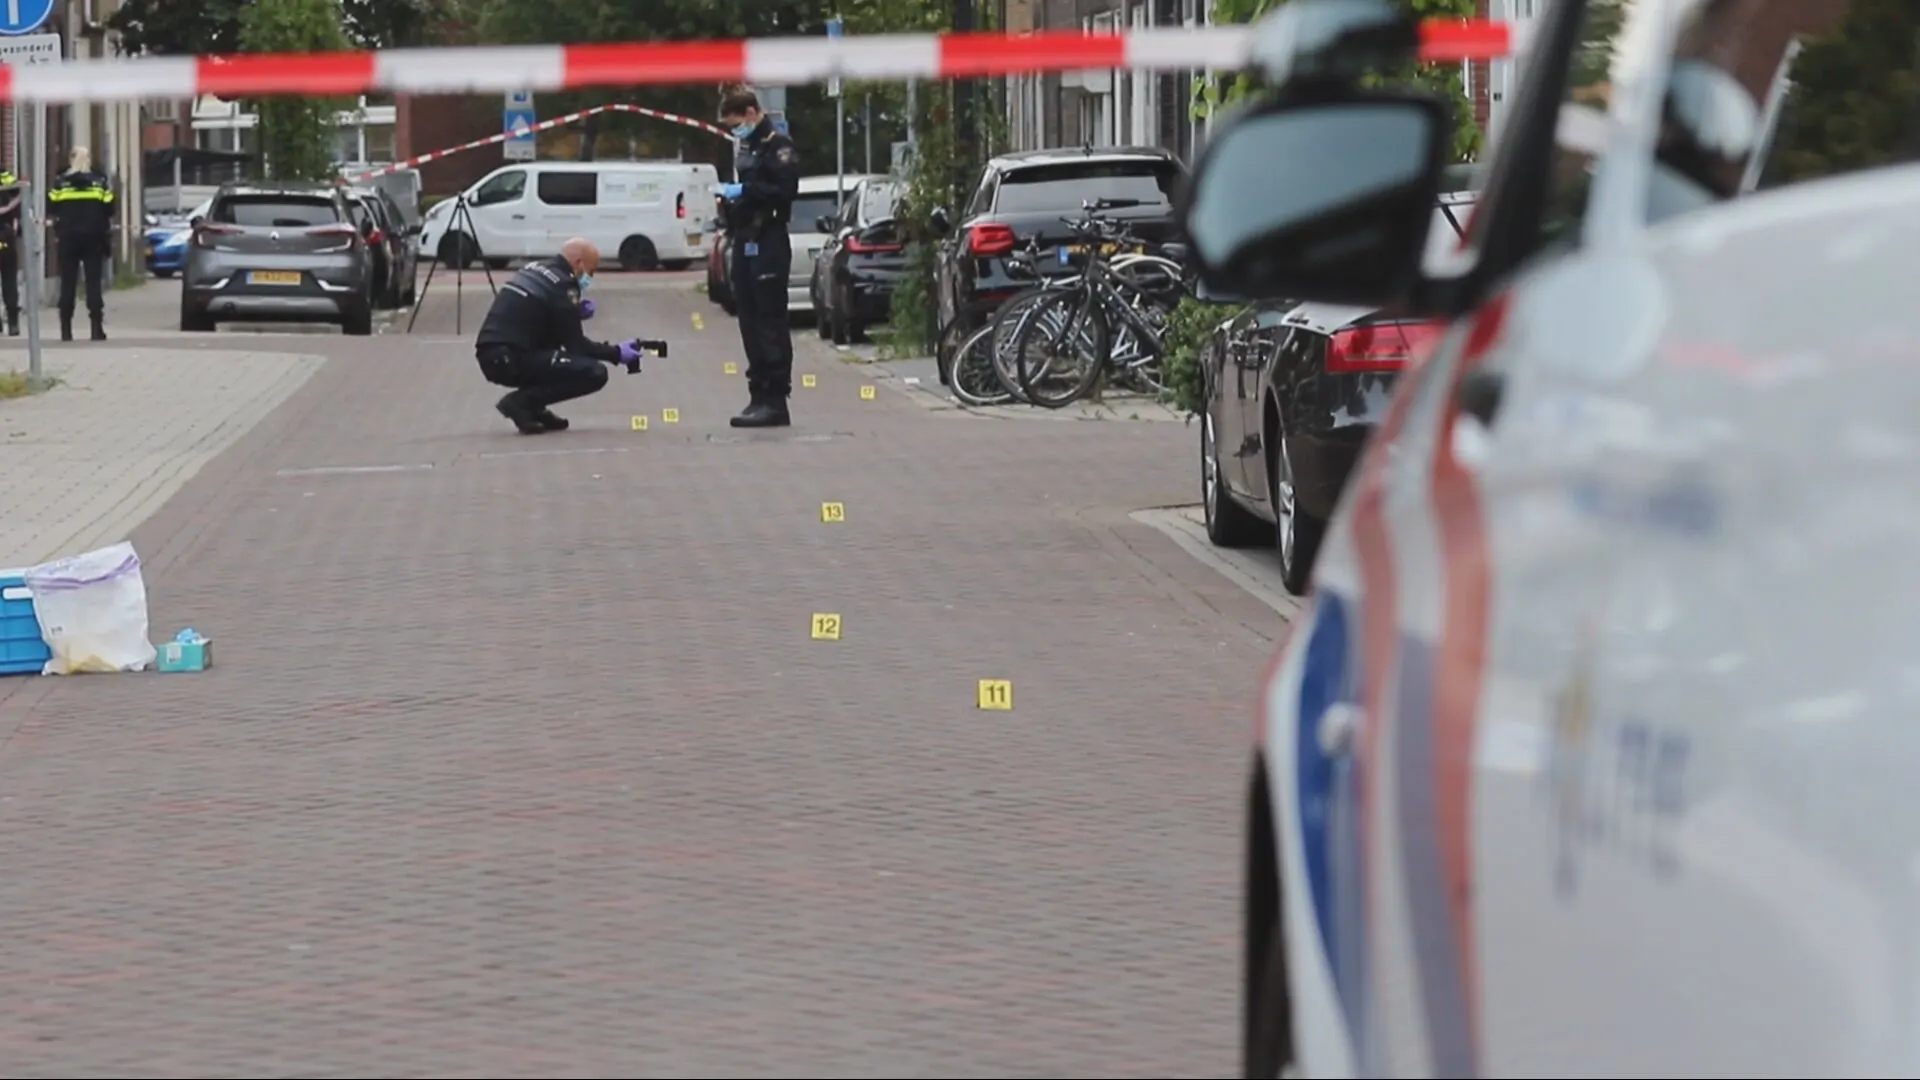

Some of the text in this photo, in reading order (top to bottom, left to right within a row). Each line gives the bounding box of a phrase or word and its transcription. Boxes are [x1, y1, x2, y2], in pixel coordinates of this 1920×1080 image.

[826, 506, 841, 518] 13
[817, 618, 837, 634] 12
[986, 686, 1005, 703] 11
